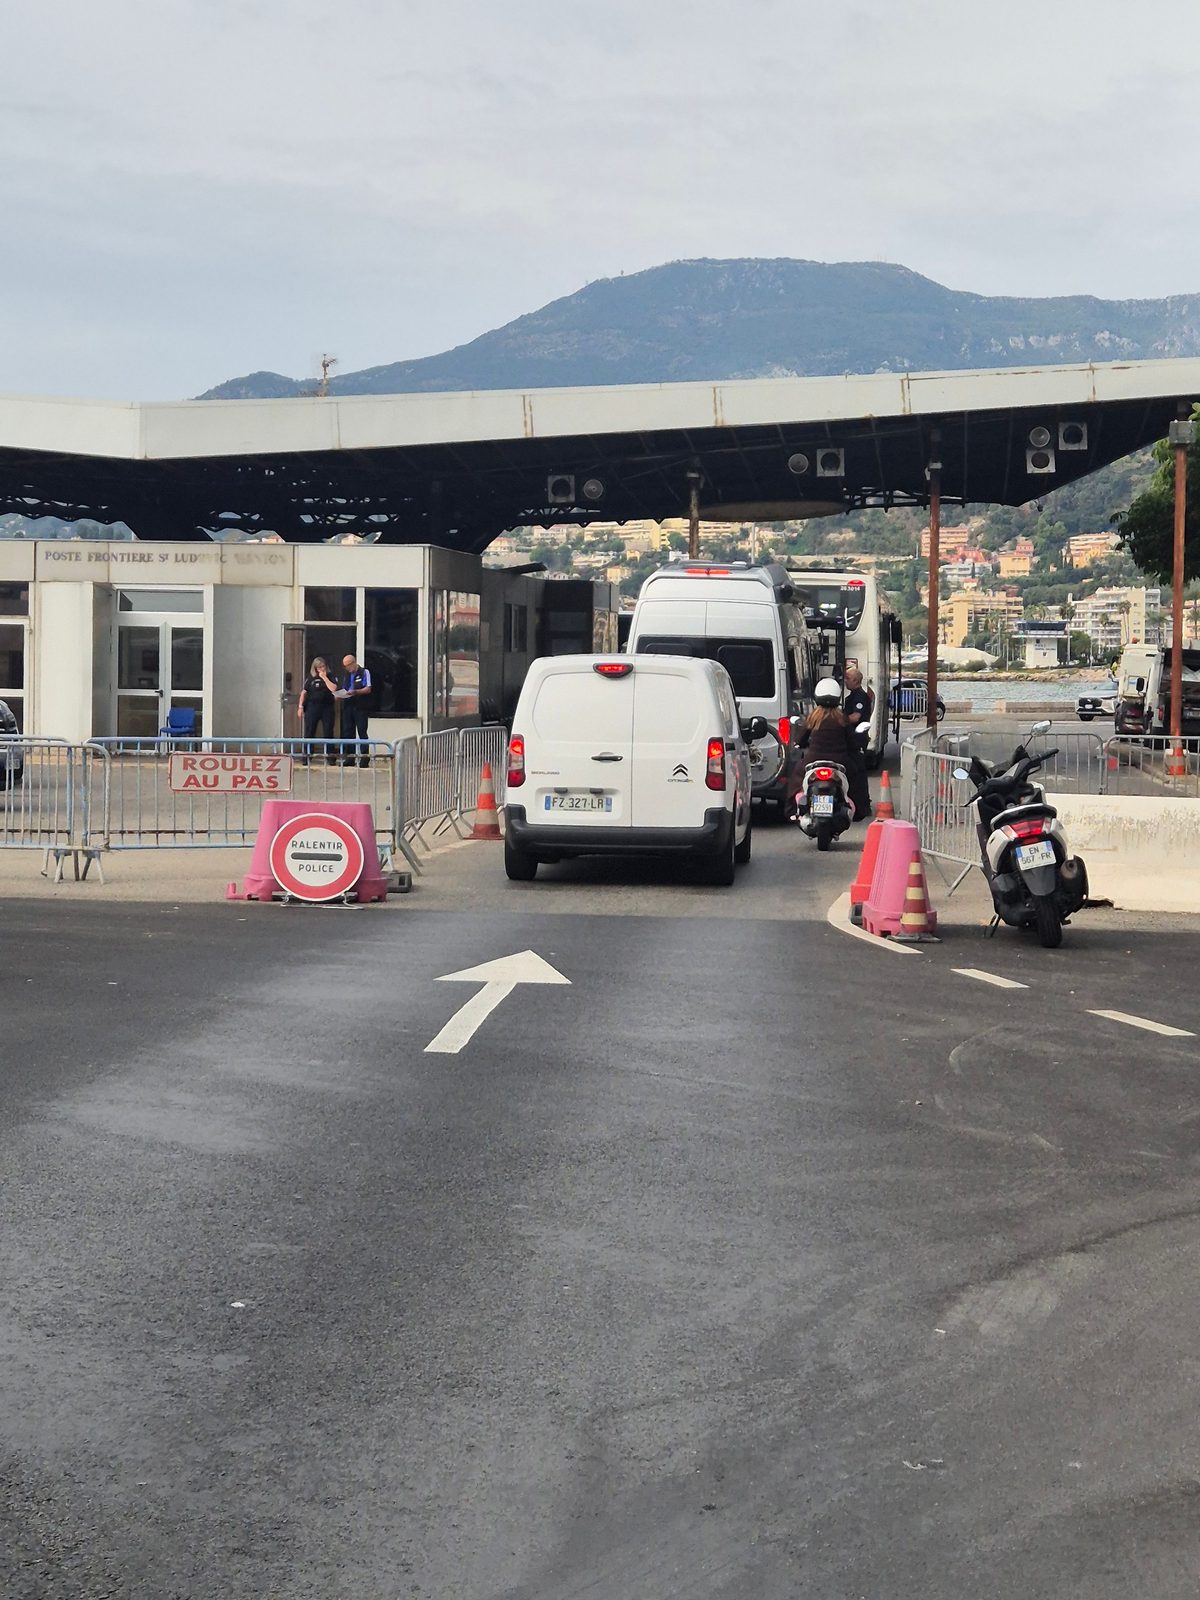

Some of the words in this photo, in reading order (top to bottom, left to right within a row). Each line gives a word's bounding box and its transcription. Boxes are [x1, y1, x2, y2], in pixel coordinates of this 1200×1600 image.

[45, 551, 82, 561] POSTE
[88, 552, 154, 563] FRONTIERE
[174, 553, 227, 563] LUDC
[182, 757, 281, 772] ROULEZ
[182, 774, 219, 788] AU
[232, 775, 279, 789] PAS
[291, 840, 343, 850] RALENTIR
[1029, 846, 1040, 855] EN
[298, 864, 334, 873] POLICE
